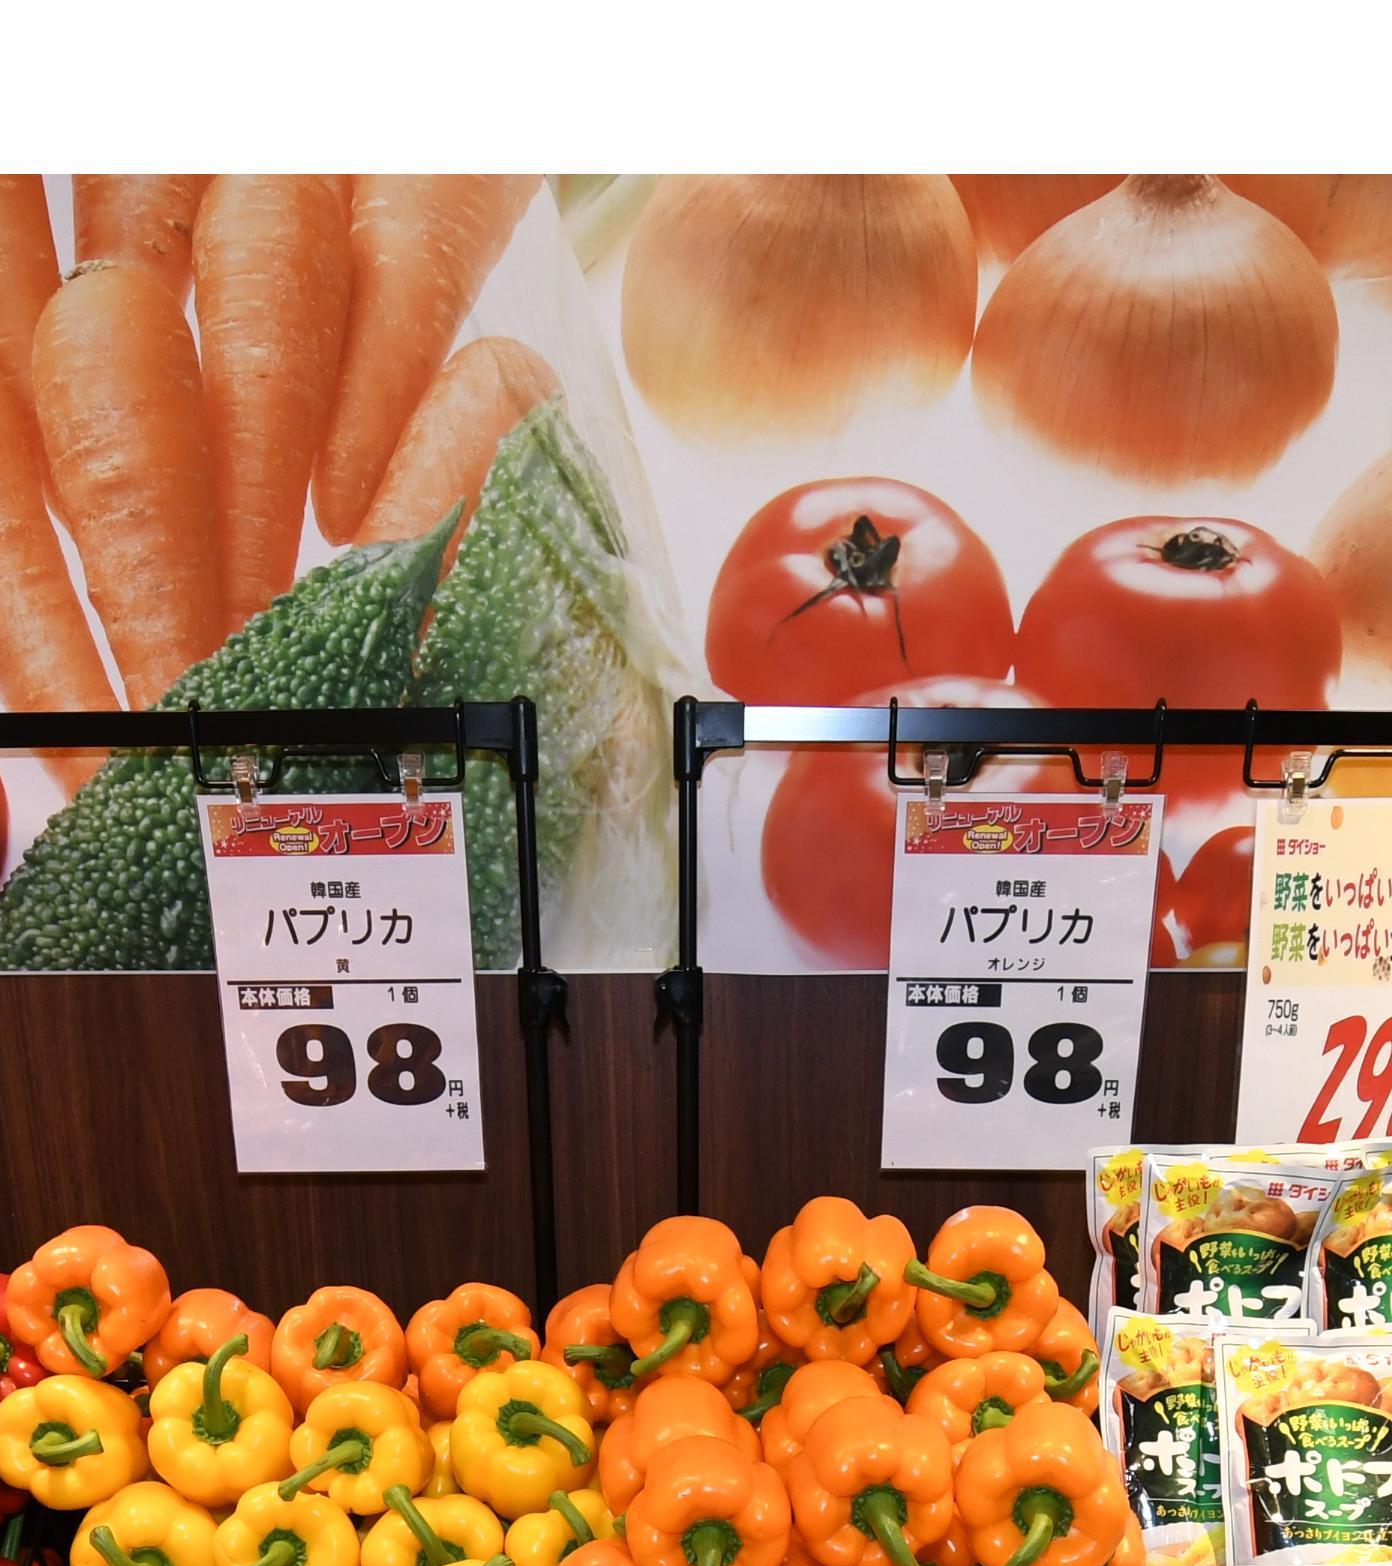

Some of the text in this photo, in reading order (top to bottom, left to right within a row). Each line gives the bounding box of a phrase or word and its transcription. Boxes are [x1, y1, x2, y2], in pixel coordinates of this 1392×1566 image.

[273, 832, 312, 843] Renewal
[318, 813, 447, 854] オープン
[967, 830, 1007, 841] Renewal
[1013, 814, 1146, 853] オープン
[1287, 838, 1326, 856] ダイショー
[310, 881, 361, 899] 韓国産
[995, 880, 1046, 898] 韓国産
[264, 907, 413, 946] パプリカ
[940, 904, 1094, 945] パプリカ
[336, 959, 350, 974] 黄
[986, 957, 1046, 971] オレンジ
[240, 988, 311, 1007] 本体価格
[908, 985, 980, 1004] 本体価格
[1267, 999, 1300, 1021] 750g
[275, 1023, 447, 1107] 98
[936, 1021, 1104, 1104] 98
[448, 1079, 463, 1097] 円
[1104, 1079, 1119, 1097] 円
[445, 1102, 469, 1120] +税
[1097, 1101, 1120, 1119] +税
[1175, 1192, 1208, 1212] 主役!
[1174, 1276, 1302, 1319] ポトフ
[1305, 1497, 1373, 1521] スープ
